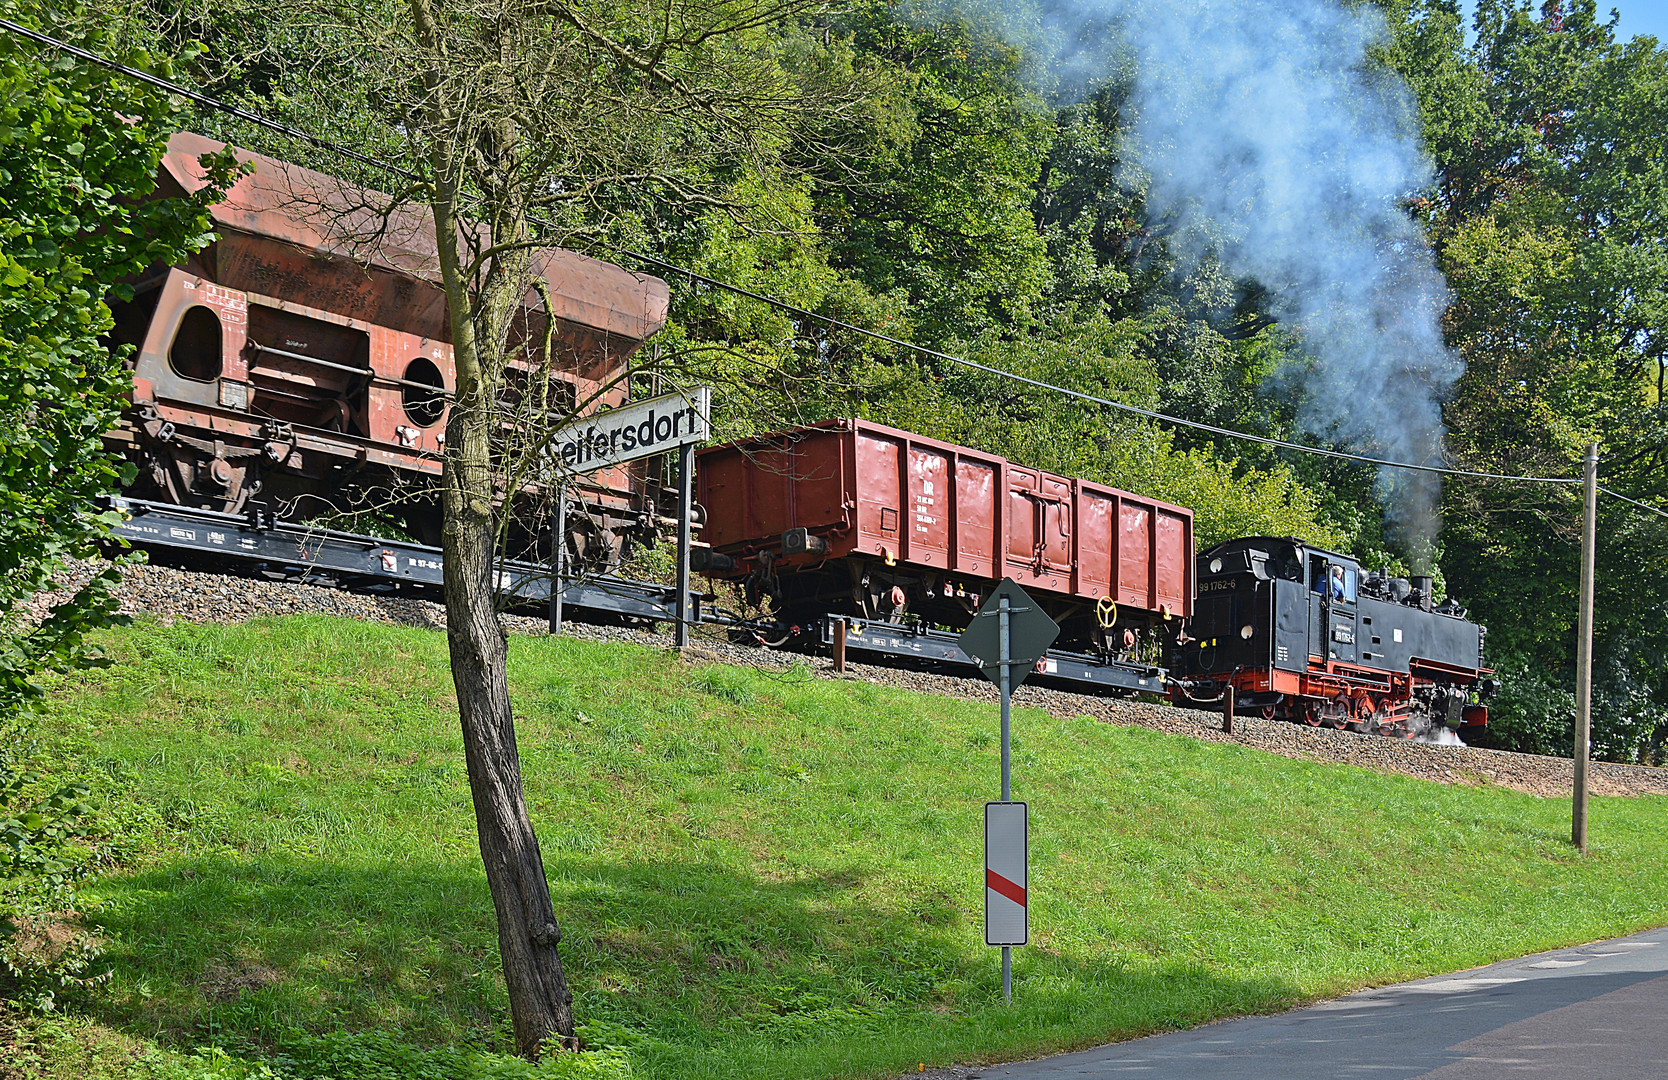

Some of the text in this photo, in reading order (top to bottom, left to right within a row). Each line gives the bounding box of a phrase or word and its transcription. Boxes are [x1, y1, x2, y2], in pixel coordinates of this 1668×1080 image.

[544, 396, 698, 468] Seifersdorf
[924, 480, 934, 496] DR
[1199, 579, 1236, 592] 99 1762-6
[1335, 631, 1342, 641] 99
